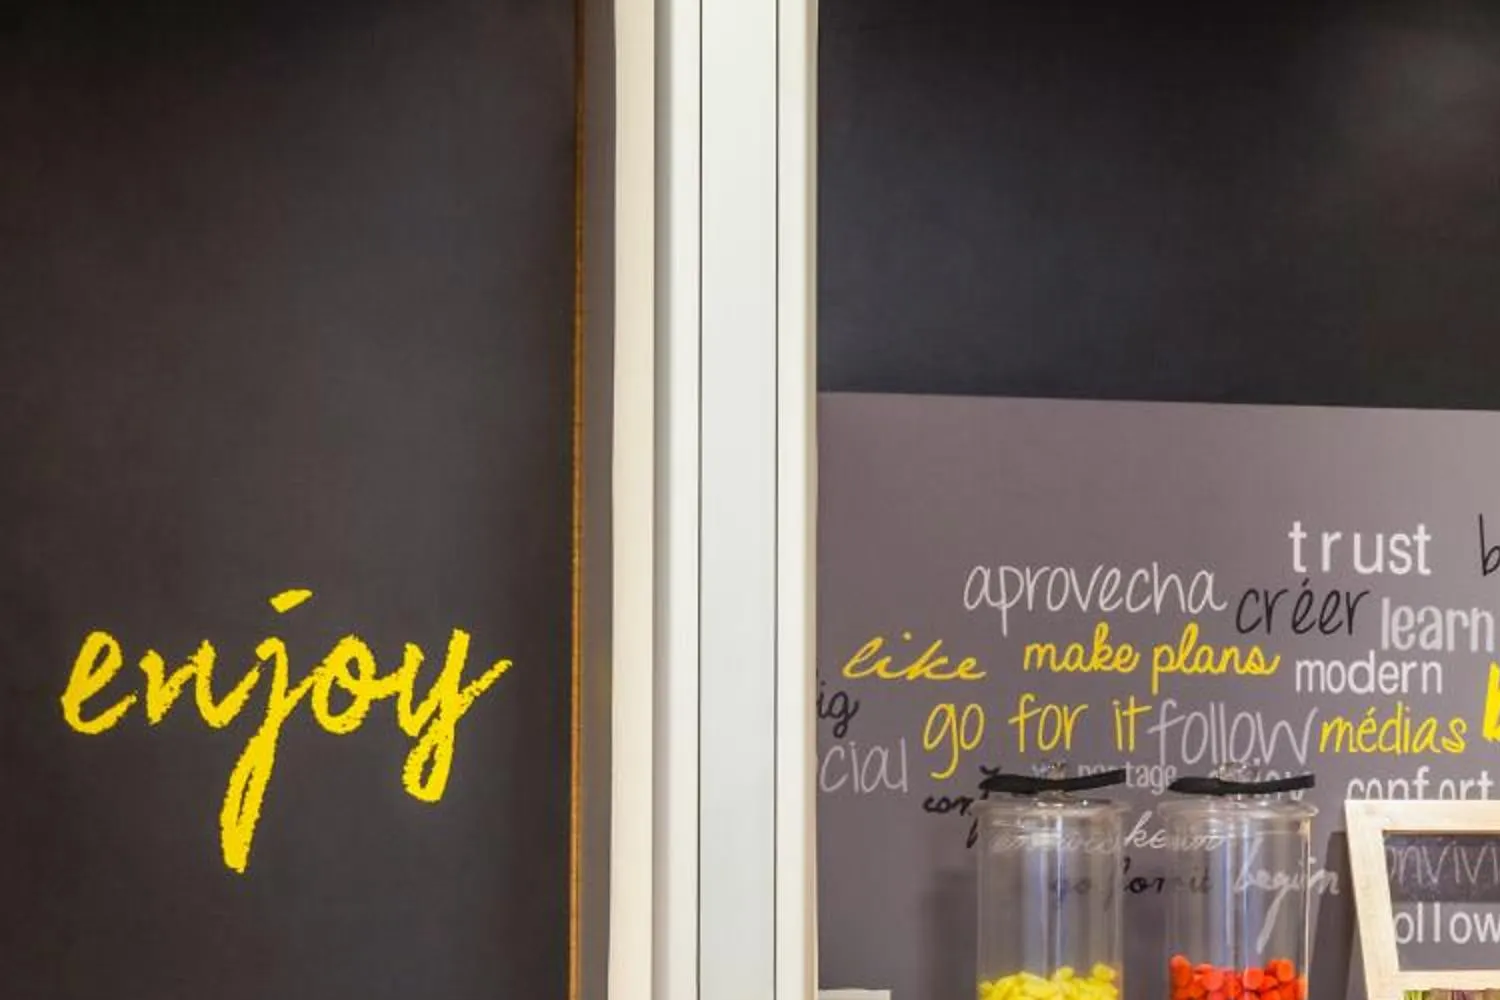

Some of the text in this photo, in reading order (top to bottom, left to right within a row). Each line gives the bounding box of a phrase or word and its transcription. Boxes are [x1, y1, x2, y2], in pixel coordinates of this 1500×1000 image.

[1288, 521, 1432, 575] trust
[963, 561, 1228, 636] aprovecha
[1235, 578, 1371, 635] créer
[1381, 597, 1494, 652] learn
[842, 631, 987, 681] like
[1023, 621, 1281, 694] make plans
[1295, 650, 1443, 694] modern
[61, 588, 513, 873] enjoy
[817, 681, 860, 739] ig
[922, 693, 1152, 780] go for it
[1149, 698, 1318, 766] follow
[1318, 700, 1468, 755] médias
[819, 736, 909, 794] cial
